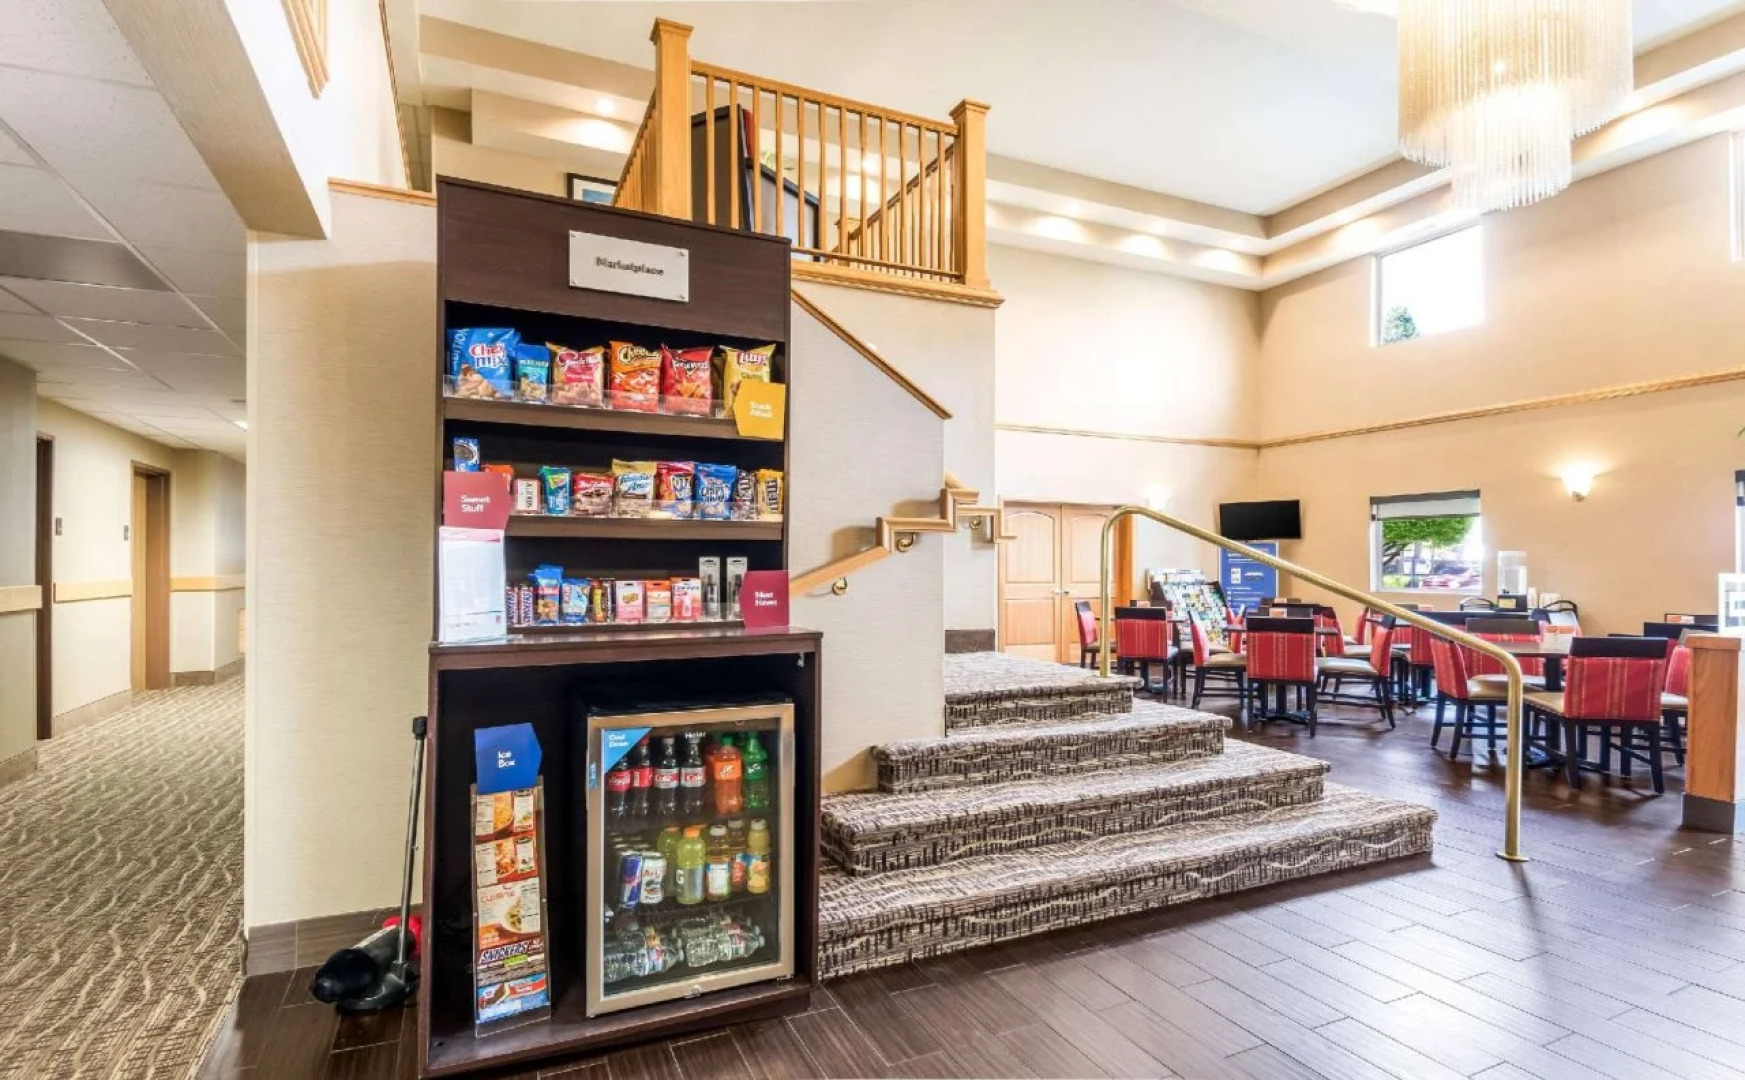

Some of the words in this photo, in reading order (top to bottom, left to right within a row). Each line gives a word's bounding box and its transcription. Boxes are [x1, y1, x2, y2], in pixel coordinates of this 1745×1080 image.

[595, 256, 664, 275] Marketplace
[460, 495, 491, 504] Sweet
[461, 504, 484, 513] Stuff
[754, 591, 774, 599] Must
[498, 751, 512, 759] Ice
[498, 759, 516, 768] Box
[481, 942, 528, 962] SNICKERS
